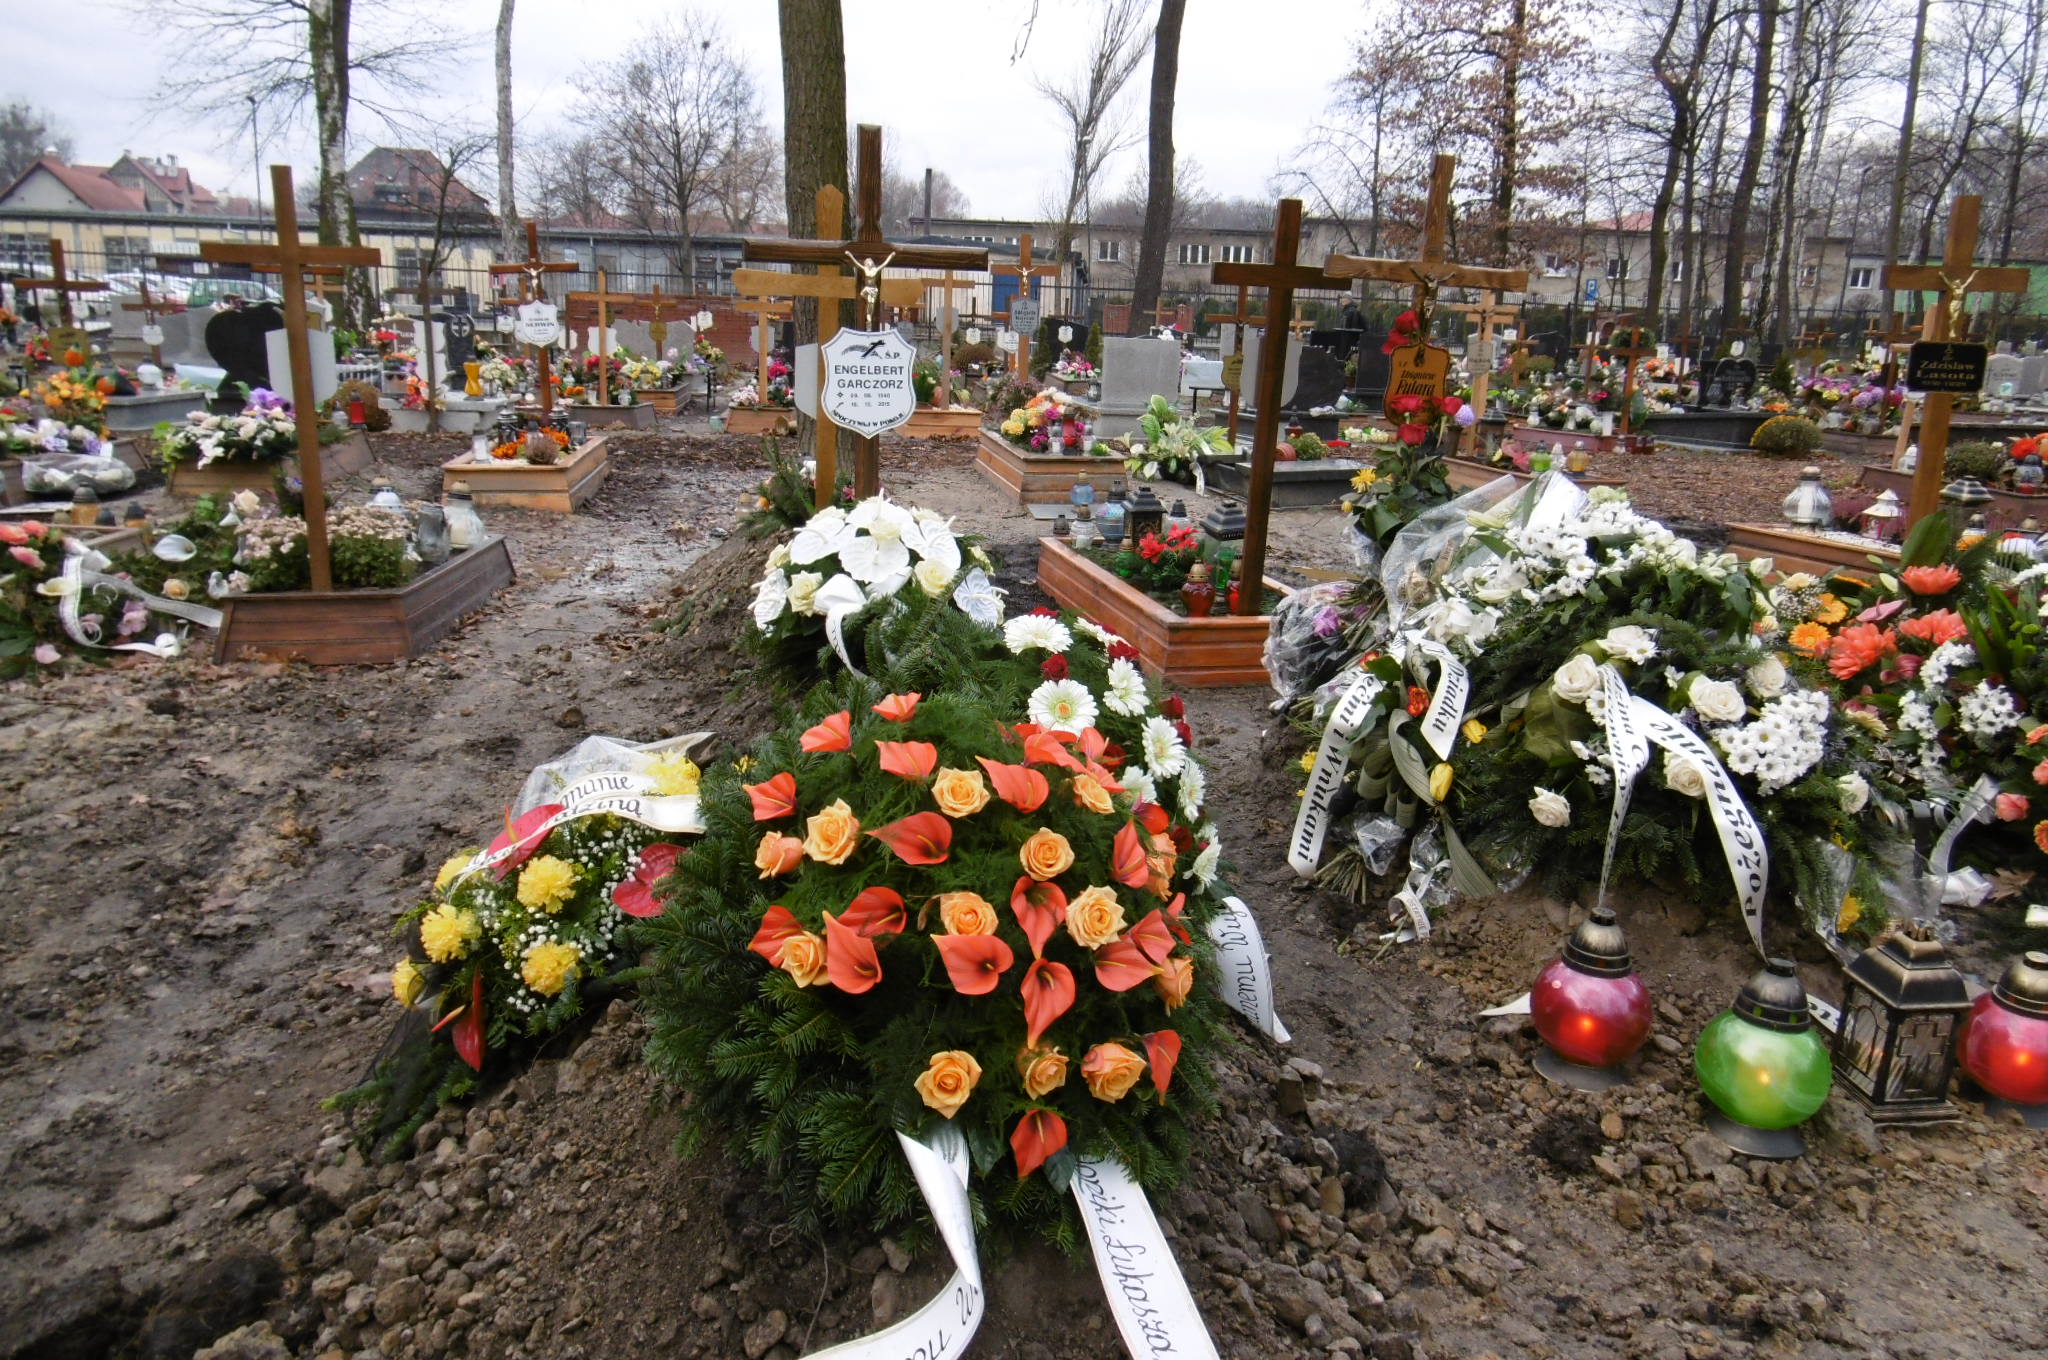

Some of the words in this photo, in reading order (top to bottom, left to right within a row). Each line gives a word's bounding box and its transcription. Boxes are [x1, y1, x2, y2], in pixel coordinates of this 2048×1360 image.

[834, 365, 904, 375] ENGELBERT
[837, 379, 903, 389] GARCZORZ
[1297, 743, 1344, 864] Wnukami
[1650, 720, 1761, 918] Pożegnanie
